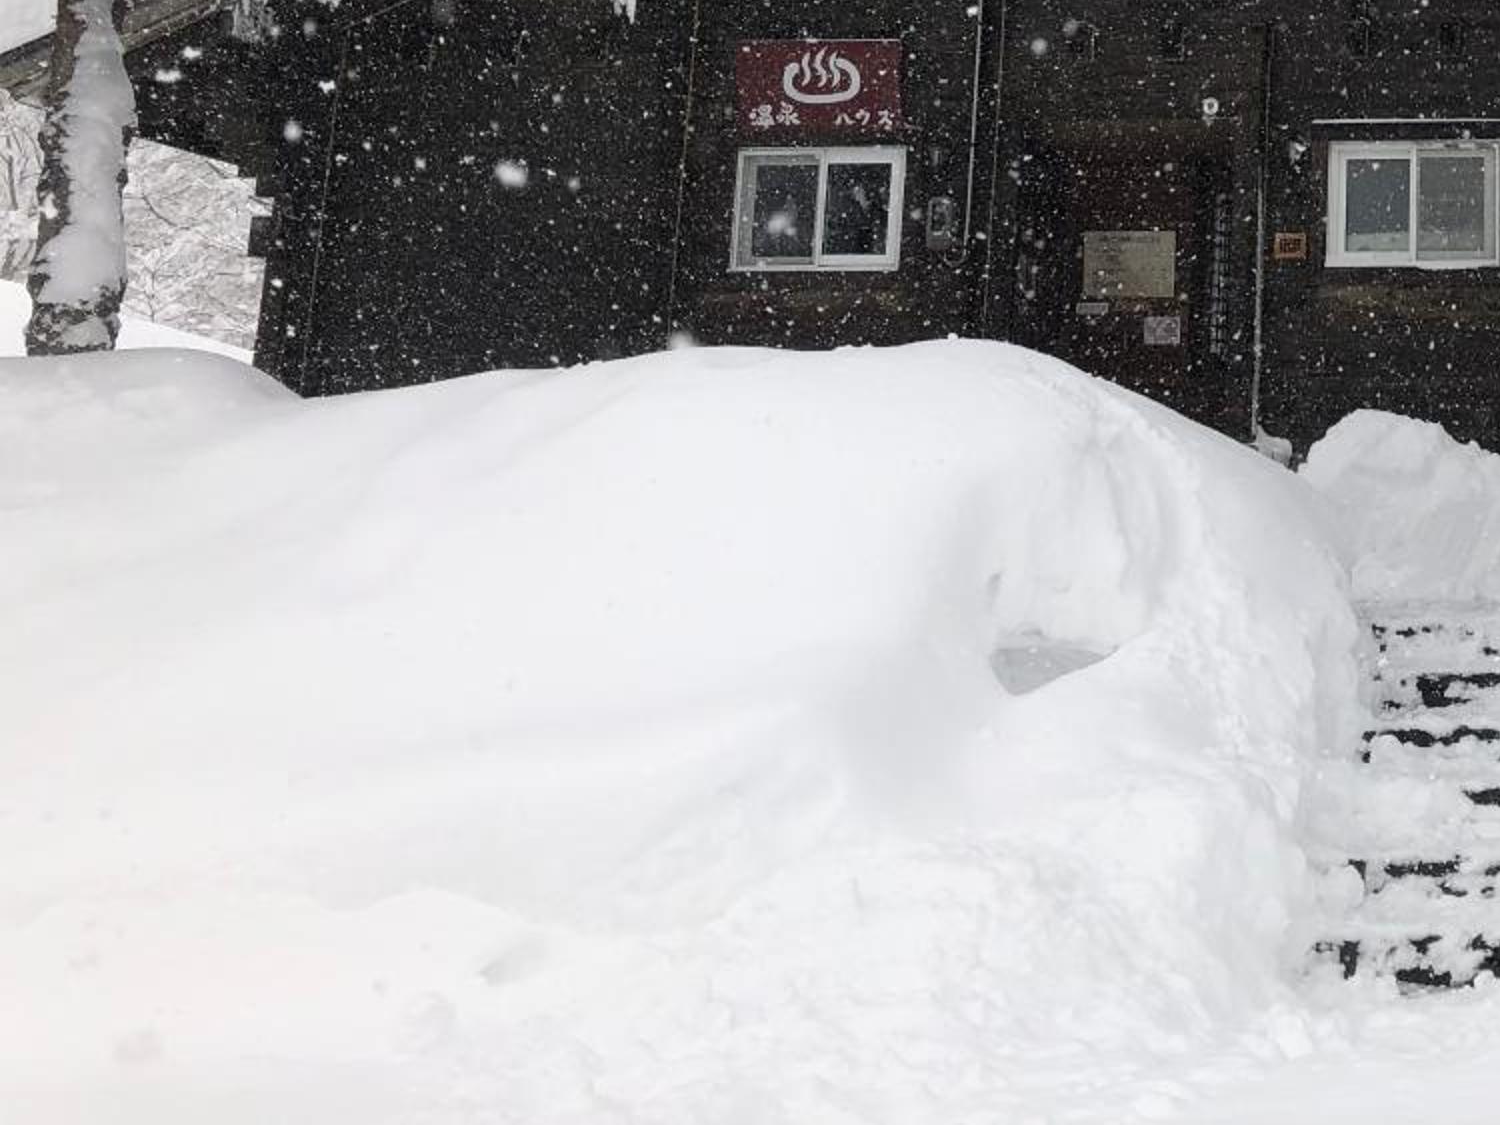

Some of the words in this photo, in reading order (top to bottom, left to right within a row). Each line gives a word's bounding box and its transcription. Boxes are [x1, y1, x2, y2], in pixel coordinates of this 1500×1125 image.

[749, 101, 800, 127] 温泉
[835, 108, 893, 127] ハウス
